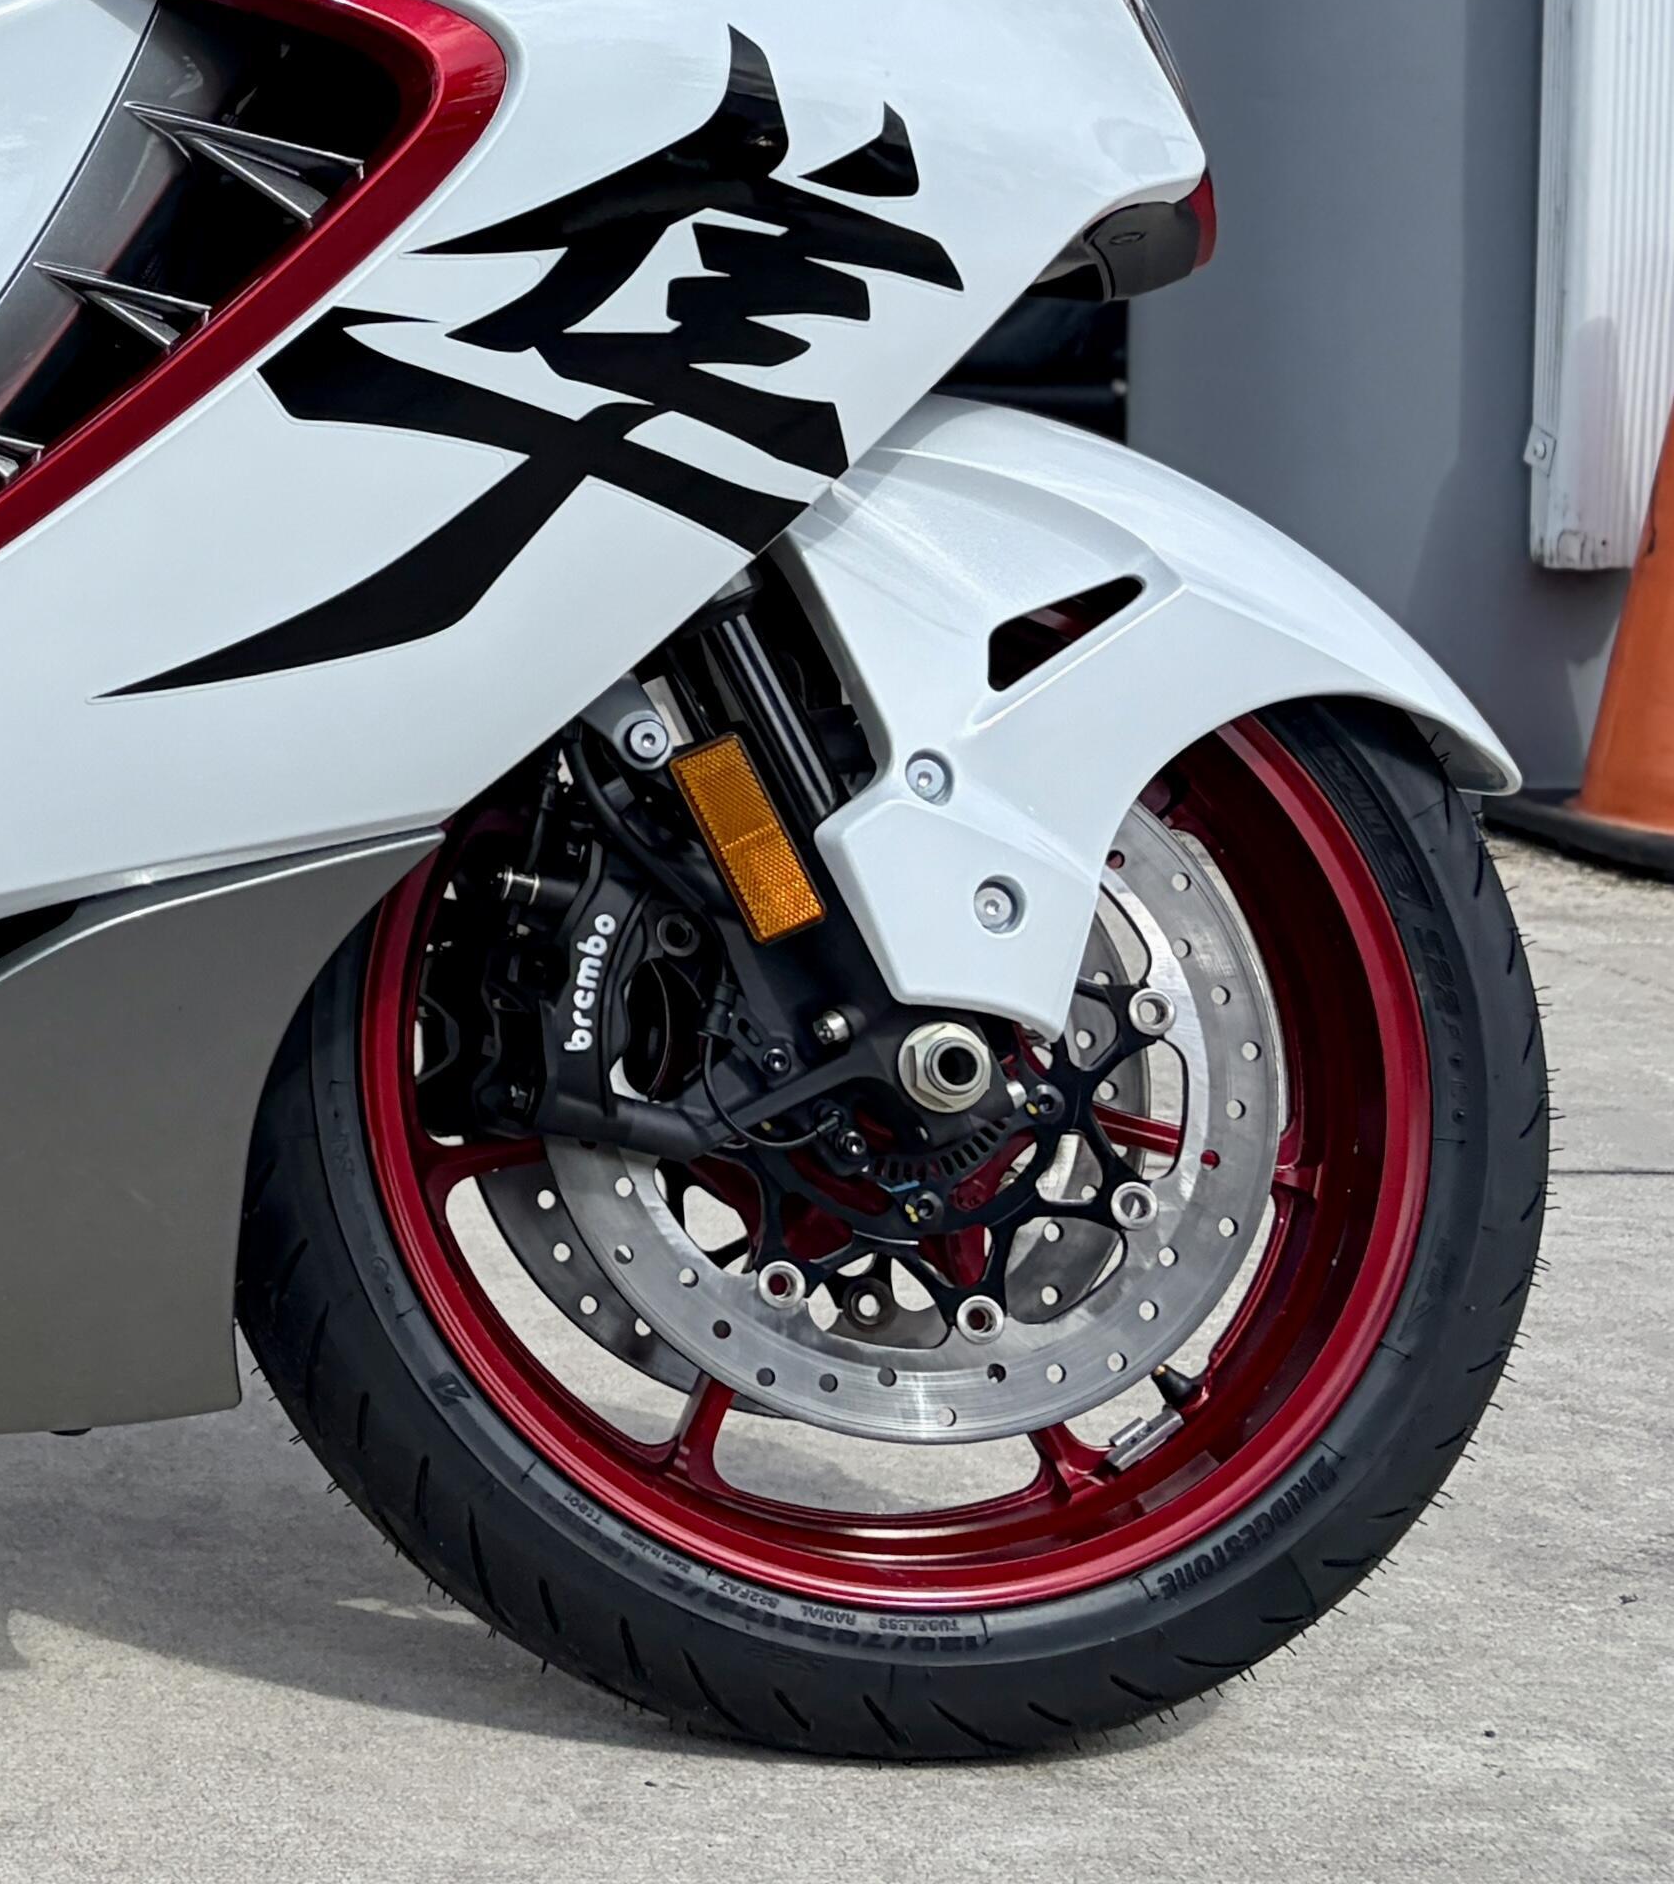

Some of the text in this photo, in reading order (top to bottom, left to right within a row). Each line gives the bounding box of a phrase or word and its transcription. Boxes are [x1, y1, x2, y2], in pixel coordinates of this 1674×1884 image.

[563, 913, 617, 1053] brembo
[1154, 1455, 1344, 1602] BRIDGESTONE
[799, 1604, 856, 1626] RADIAL
